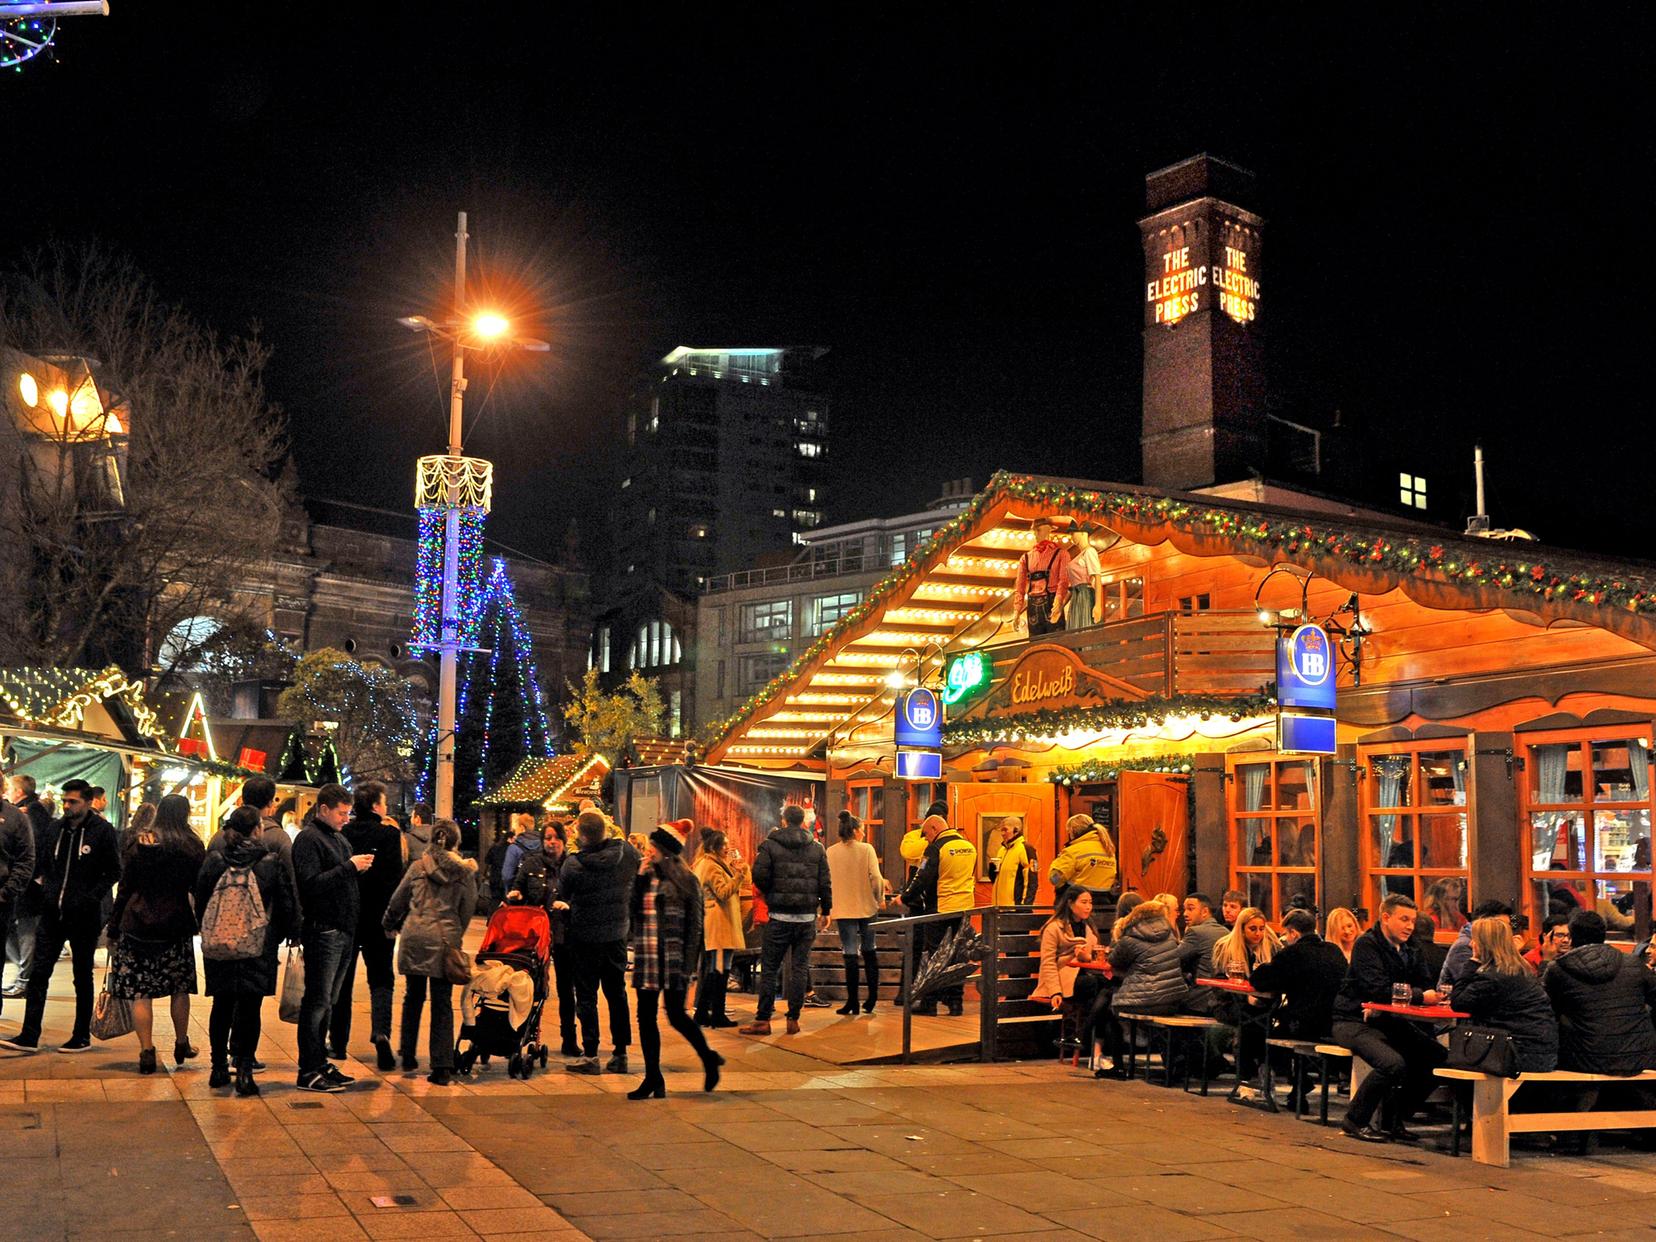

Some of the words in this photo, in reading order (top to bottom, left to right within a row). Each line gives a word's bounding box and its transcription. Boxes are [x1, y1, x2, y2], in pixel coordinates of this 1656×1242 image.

[1163, 246, 1190, 273] THE
[1225, 246, 1247, 272] THE
[1147, 266, 1207, 302] ELECTRIC
[1212, 266, 1261, 300] ELECTRIC
[1155, 292, 1199, 323] PRESS
[1220, 292, 1255, 321] PRESS
[1302, 653, 1324, 676] HB
[1012, 665, 1073, 704] Edelweiß
[913, 707, 932, 724] HB
